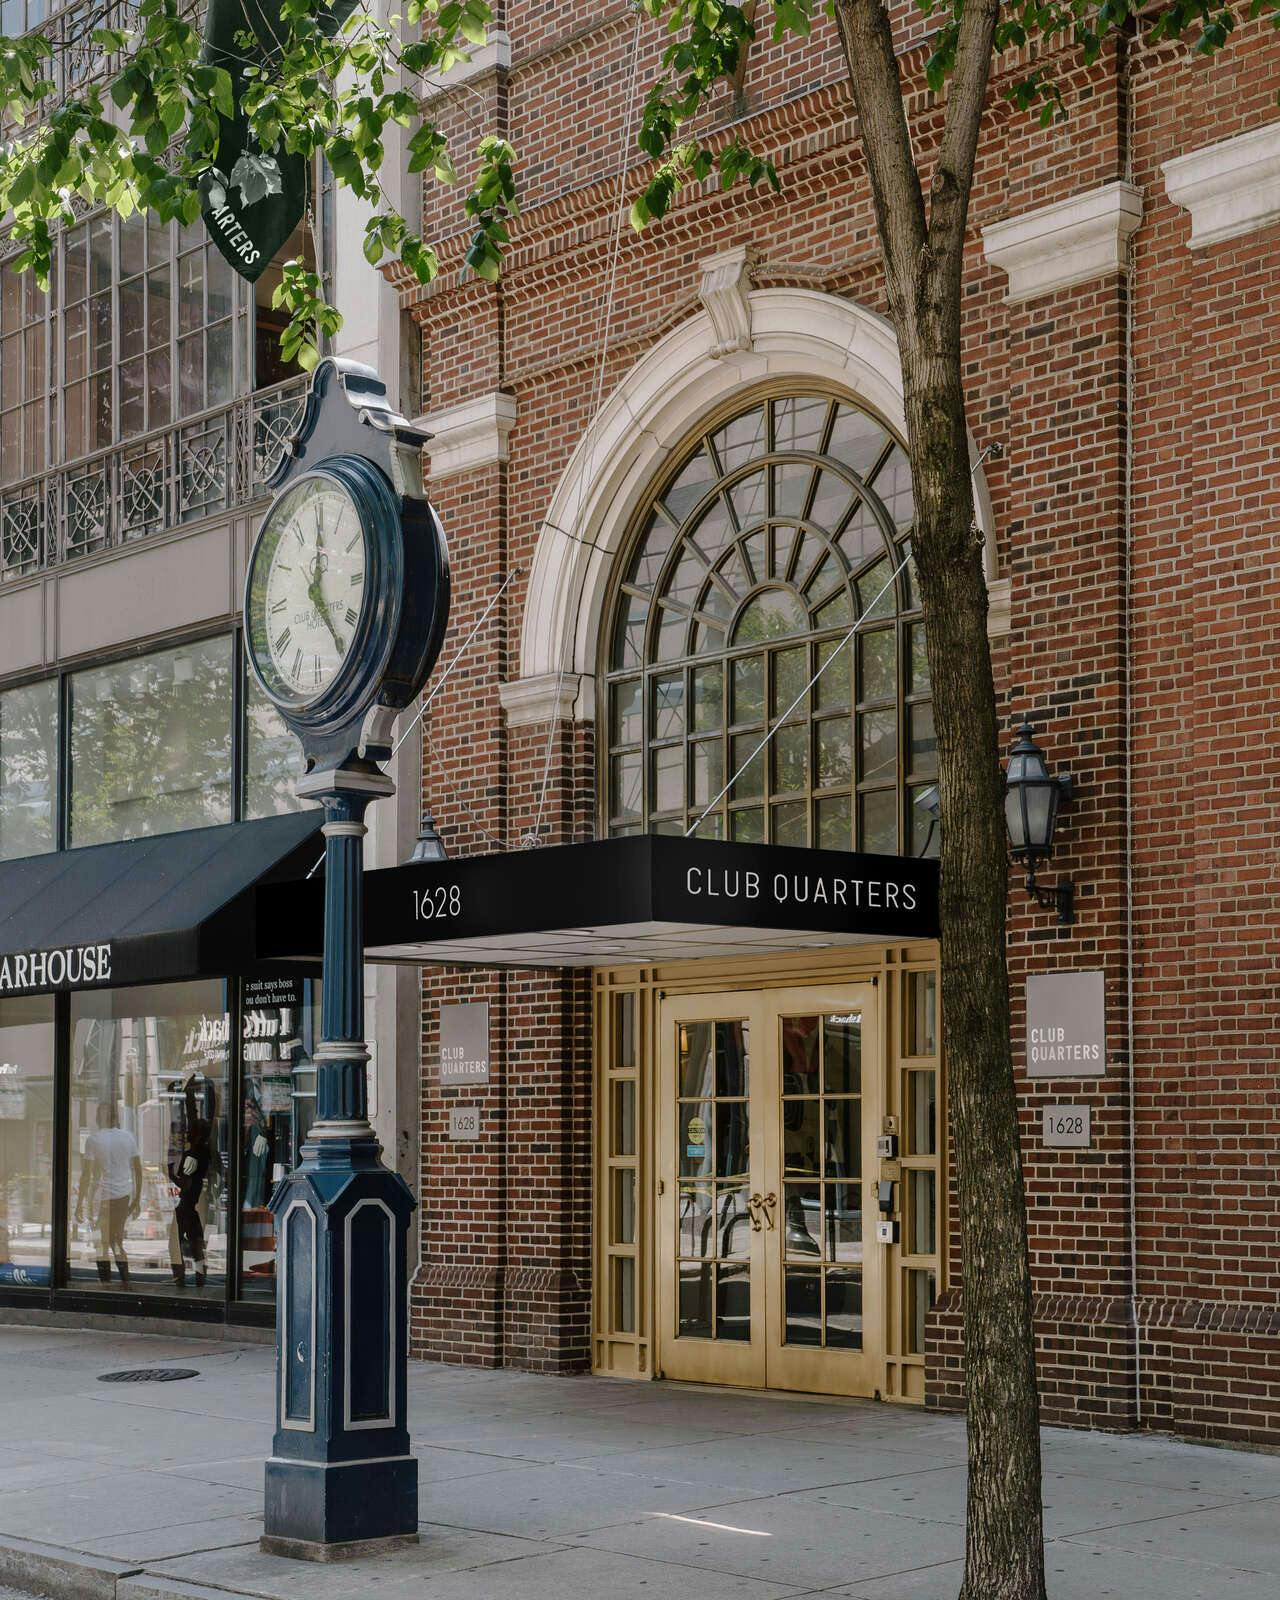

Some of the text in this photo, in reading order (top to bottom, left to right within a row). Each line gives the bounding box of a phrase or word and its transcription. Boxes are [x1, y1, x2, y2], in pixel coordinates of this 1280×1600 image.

[211, 205, 260, 264] ARTERS
[687, 867, 917, 911] CLUB QUARTERS
[412, 885, 461, 921] 1628
[0, 943, 112, 991] ARHOUSE
[264, 981, 278, 992] says
[278, 978, 293, 988] boss
[271, 993, 287, 1003] have
[1031, 1027, 1065, 1043] CLUB
[441, 1047, 465, 1060] CLUB
[1031, 1044, 1100, 1064] QUARTERS
[441, 1060, 487, 1076] QUARTERS
[453, 1116, 475, 1130] 1628
[1048, 1117, 1083, 1134] 1628
